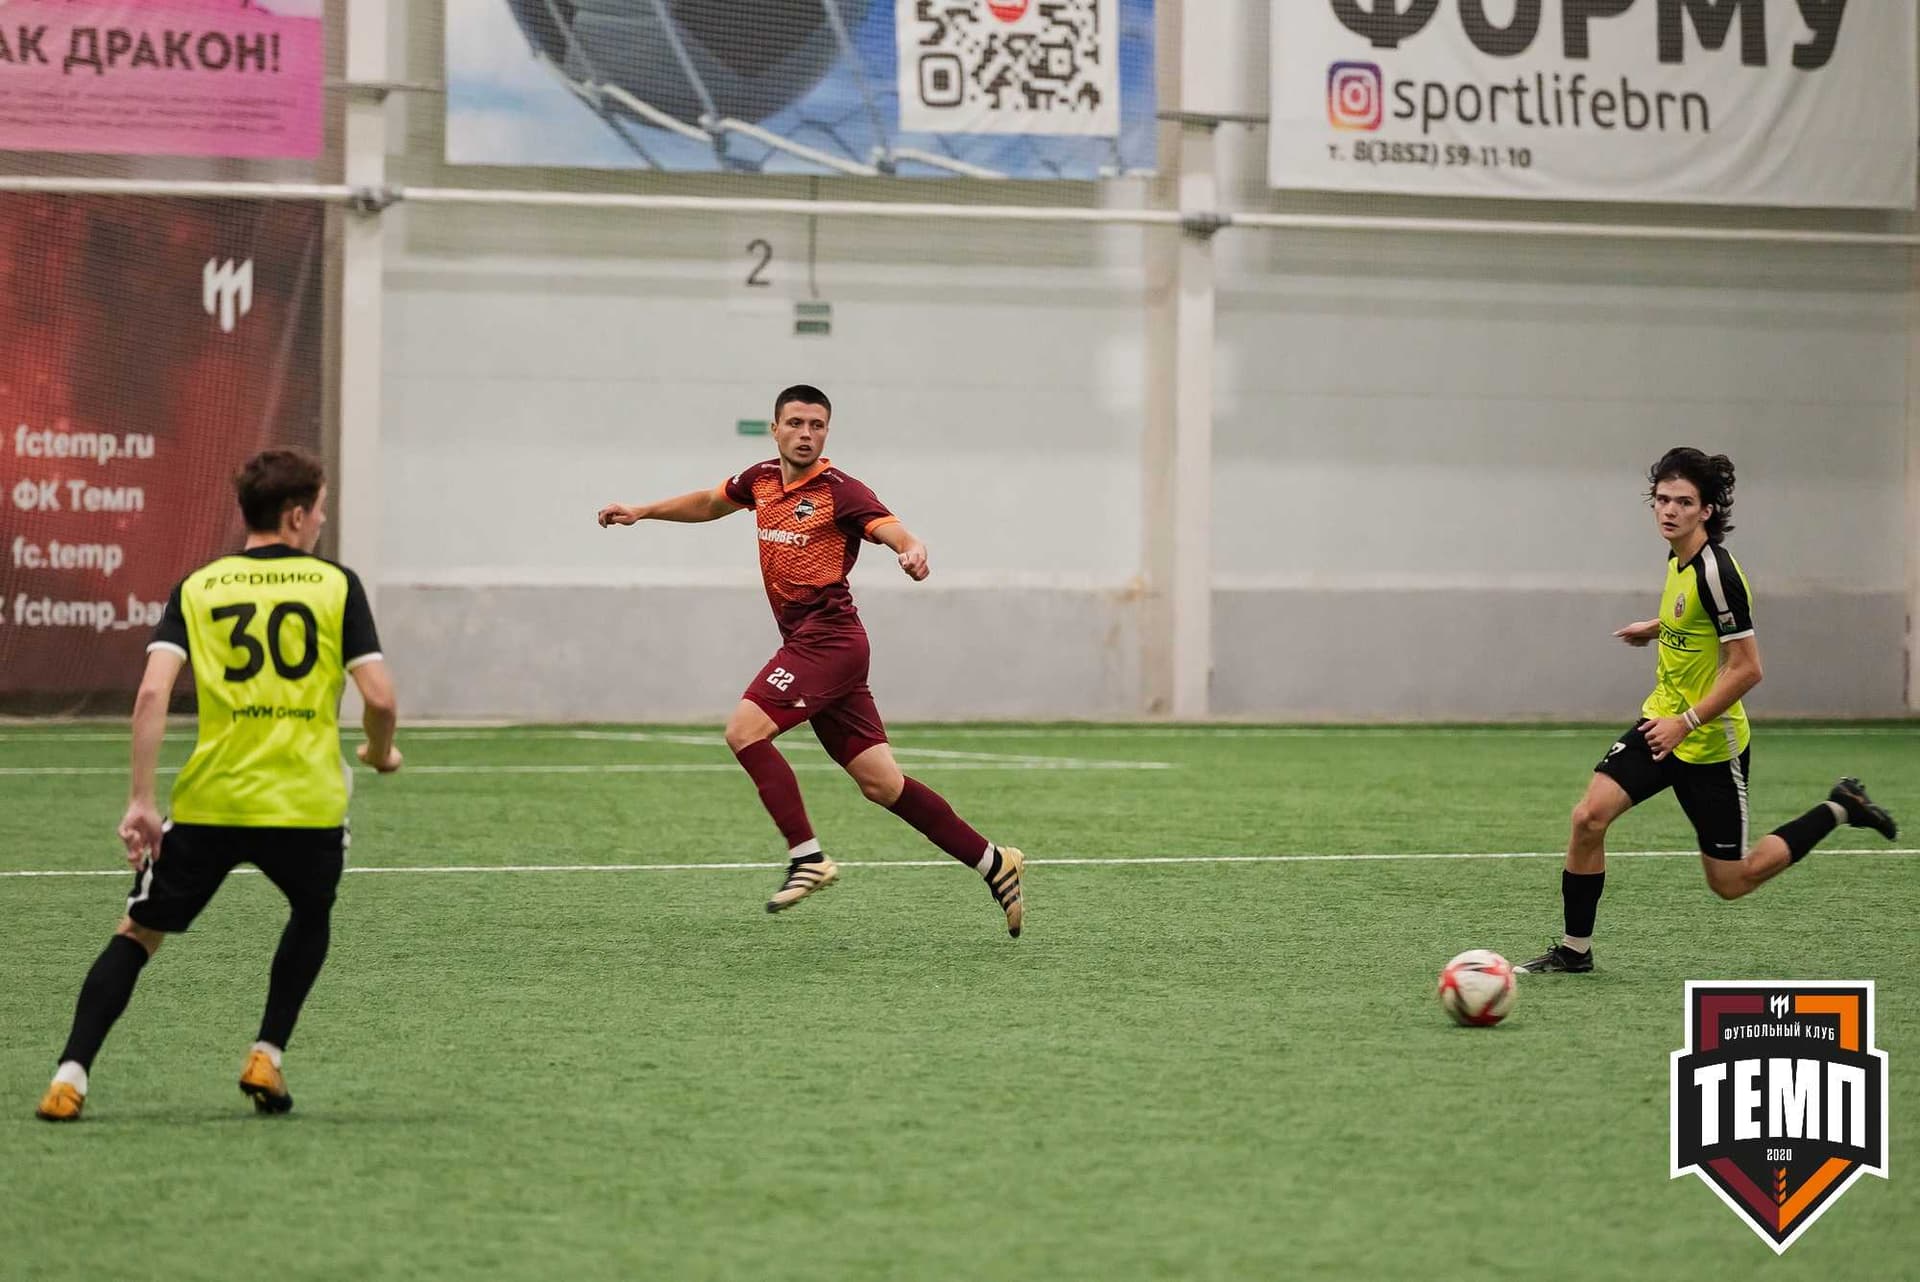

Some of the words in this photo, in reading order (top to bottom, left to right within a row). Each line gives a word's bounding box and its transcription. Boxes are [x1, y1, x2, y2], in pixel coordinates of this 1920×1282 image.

[63, 27, 281, 76] ДРАКОН!
[1393, 72, 1711, 133] sportlifebrn
[746, 238, 773, 287] 2
[15, 424, 155, 466] fctemp.ru
[13, 478, 61, 511] ФК
[67, 479, 145, 512] Темп
[13, 536, 123, 578] fc.temp
[204, 571, 323, 590] #сервико
[211, 601, 319, 682] 30
[766, 667, 795, 691] 22
